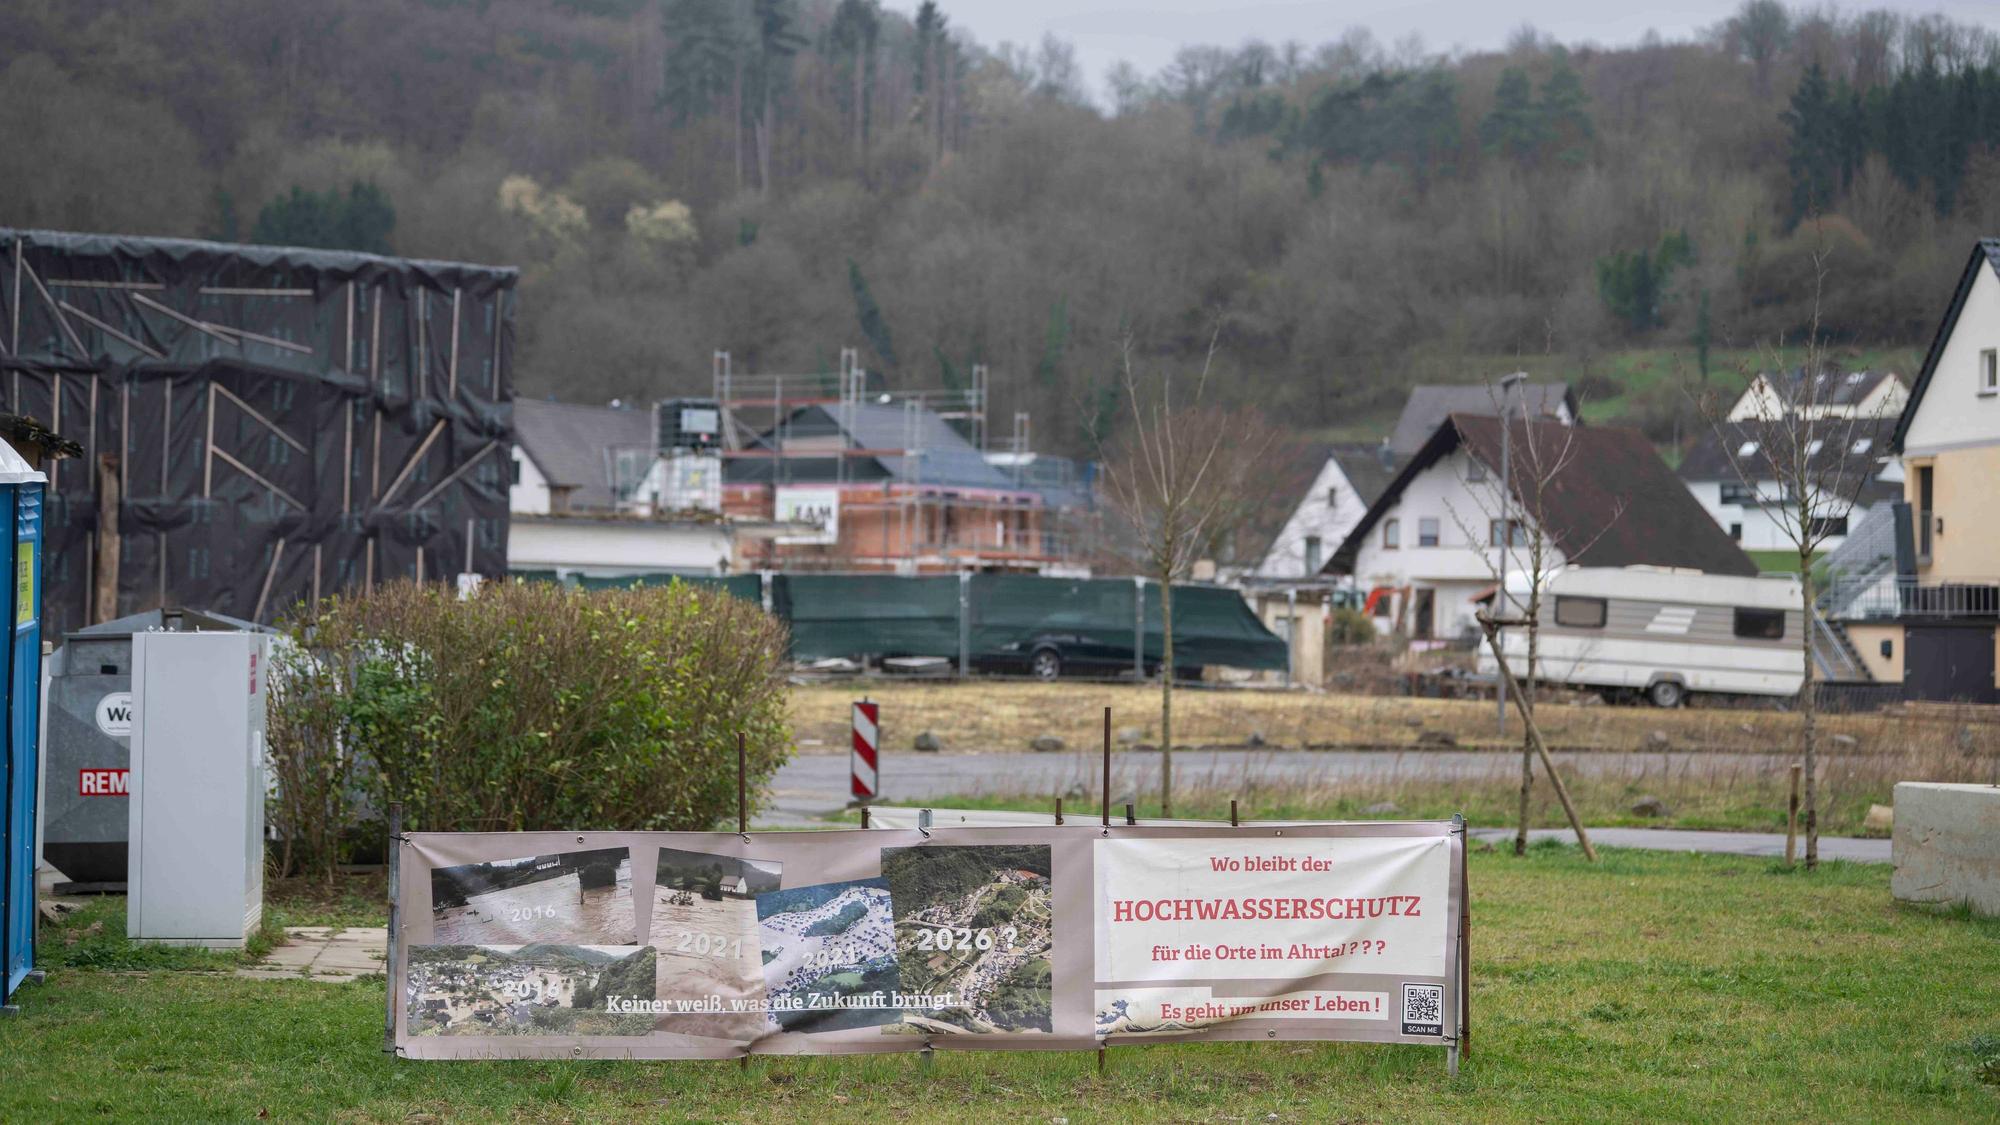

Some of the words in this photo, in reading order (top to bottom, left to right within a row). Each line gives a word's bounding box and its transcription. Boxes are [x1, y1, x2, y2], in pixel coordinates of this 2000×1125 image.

[1210, 857, 1240, 872] Wo
[1244, 856, 1297, 872] bleibt
[1301, 856, 1333, 872] der
[511, 904, 556, 922] 2016
[1113, 896, 1421, 923] HOCHWASSERSCHUTZ
[676, 931, 743, 960] 2021
[917, 927, 993, 951] 2026
[802, 945, 857, 969] 2021
[1151, 945, 1180, 962] für
[1184, 944, 1211, 960] die
[1215, 944, 1256, 960] Orte
[1260, 943, 1283, 960] im
[1287, 943, 1345, 960] Ahrtal
[605, 995, 672, 1013] Keiner
[676, 994, 726, 1013] weiß,
[730, 999, 768, 1011] was
[773, 993, 803, 1010] die
[807, 990, 887, 1009] Zukunft
[1161, 1003, 1181, 1020] Es
[1185, 1003, 1225, 1023] geht
[1229, 1005, 1256, 1017] um
[1259, 998, 1310, 1013] unser
[1314, 995, 1370, 1013] Leben
[1407, 1025, 1426, 1033] SCAN
[1426, 1026, 1438, 1034] ME
